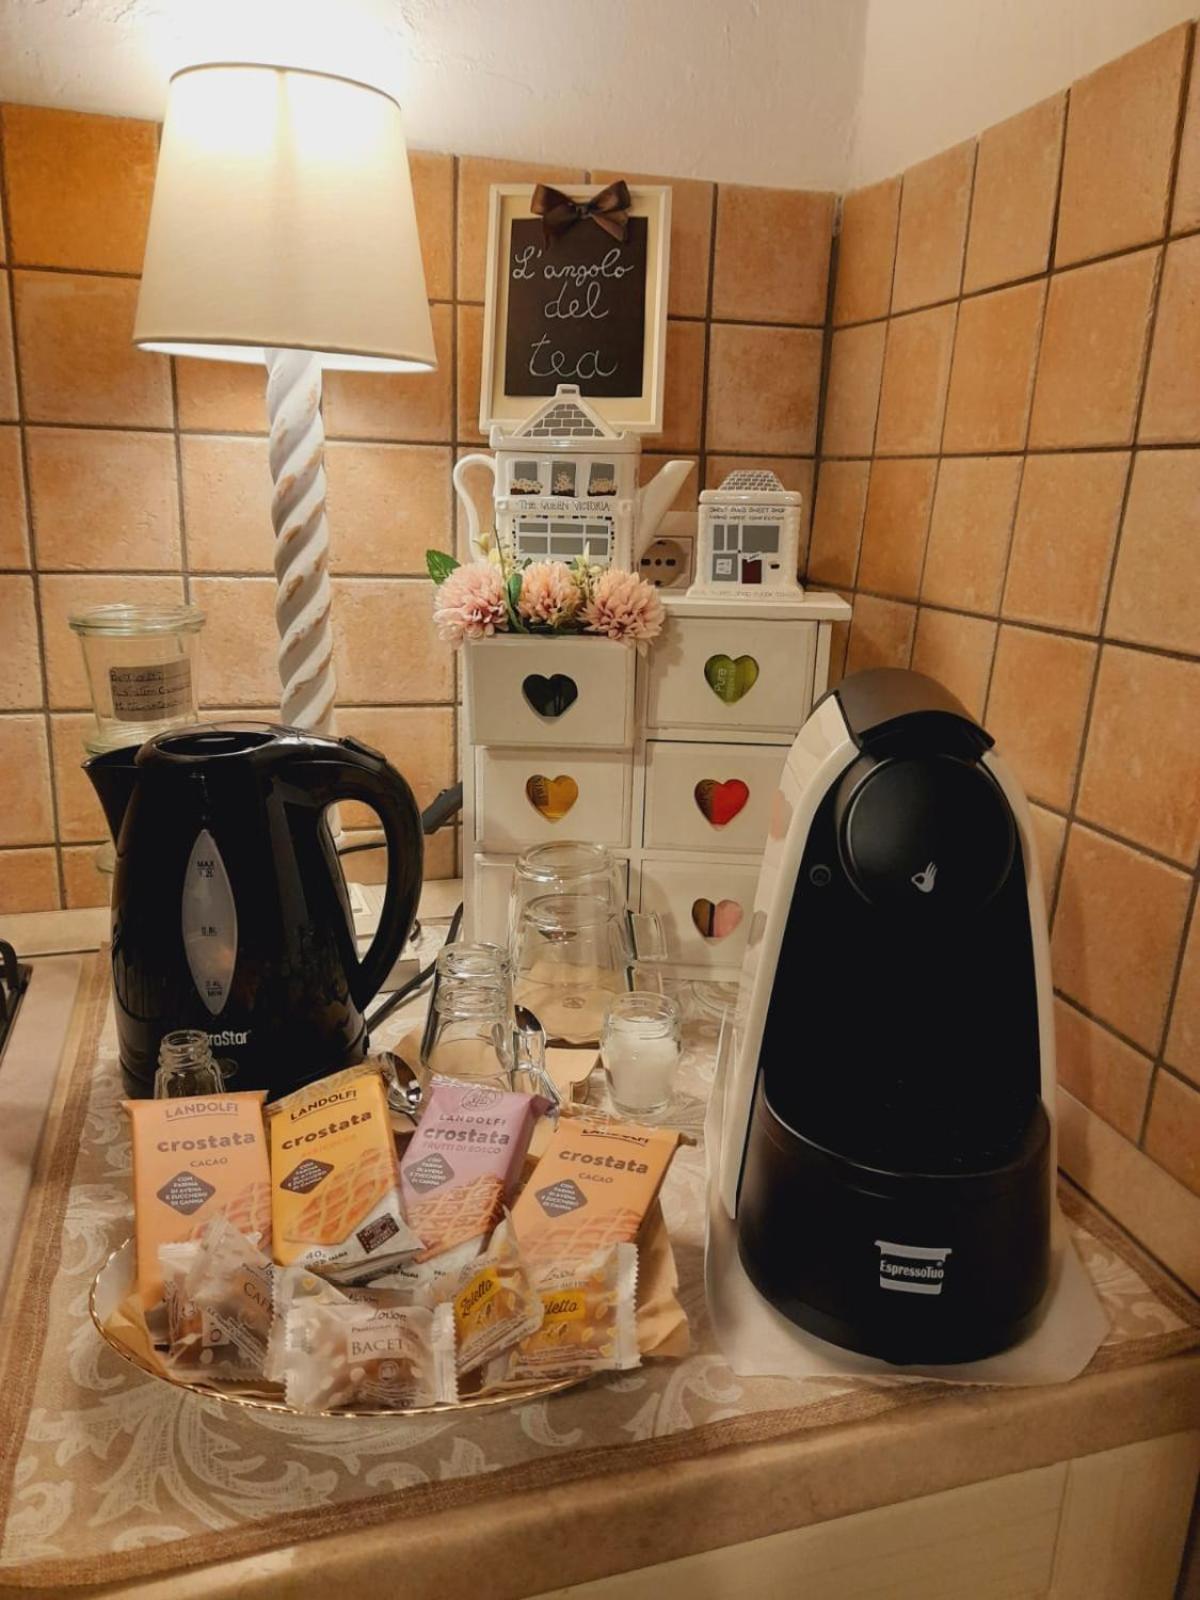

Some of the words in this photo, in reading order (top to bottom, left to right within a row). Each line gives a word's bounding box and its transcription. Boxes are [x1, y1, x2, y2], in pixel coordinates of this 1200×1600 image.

[512, 246, 634, 287] L'angolo
[544, 280, 609, 319] del
[528, 332, 618, 379] tea
[165, 1102, 239, 1119] LANDOLFI
[289, 1089, 357, 1121] LANDOLFI
[281, 1110, 373, 1151] crostata
[439, 1113, 506, 1127] LANDOLFI
[156, 1130, 256, 1153] crostata
[423, 1125, 511, 1146] crostata
[190, 1157, 229, 1169] CACAO
[558, 1149, 649, 1176] crostata
[579, 1172, 614, 1184] CACAO
[880, 1260, 944, 1279] EspressoTuo
